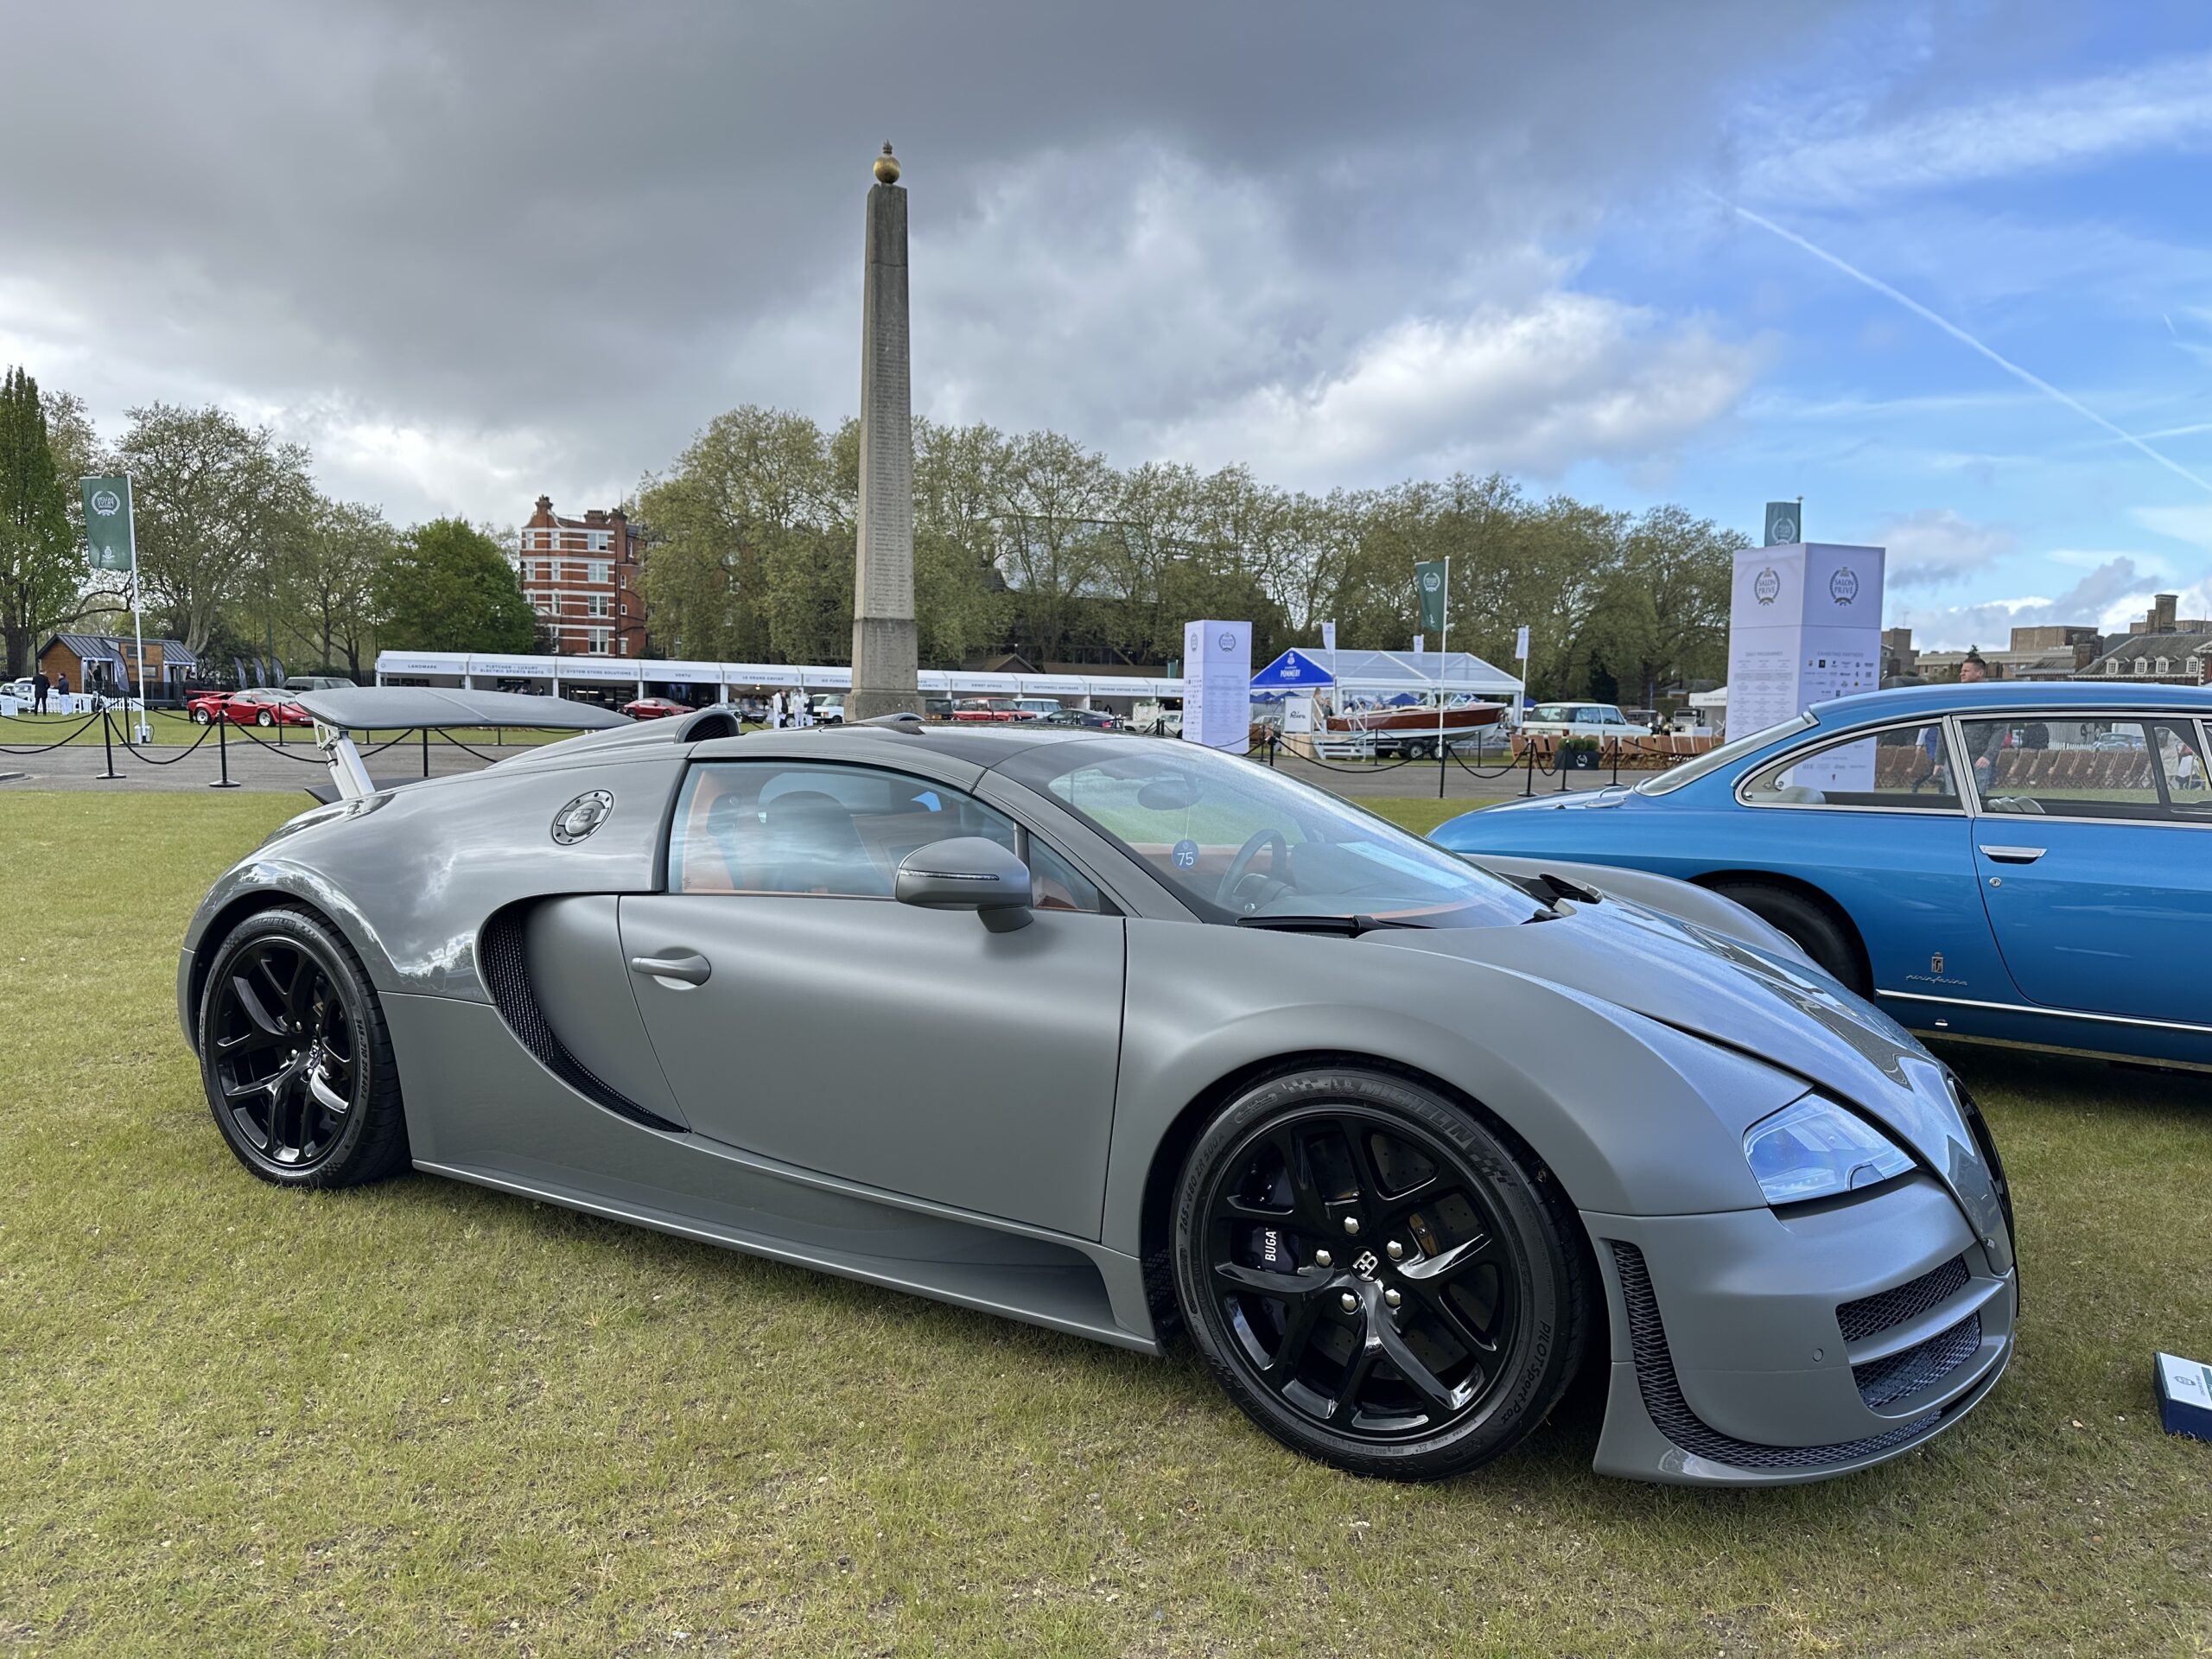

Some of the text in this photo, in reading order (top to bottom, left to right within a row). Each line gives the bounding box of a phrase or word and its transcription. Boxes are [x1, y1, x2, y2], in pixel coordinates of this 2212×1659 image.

[1834, 578, 1854, 587] SALON
[1177, 851, 1194, 866] 75
[1359, 1082, 1472, 1143] MICHELIN
[1264, 1227, 1277, 1262] BUGA
[1518, 1363, 1541, 1403] Sport
